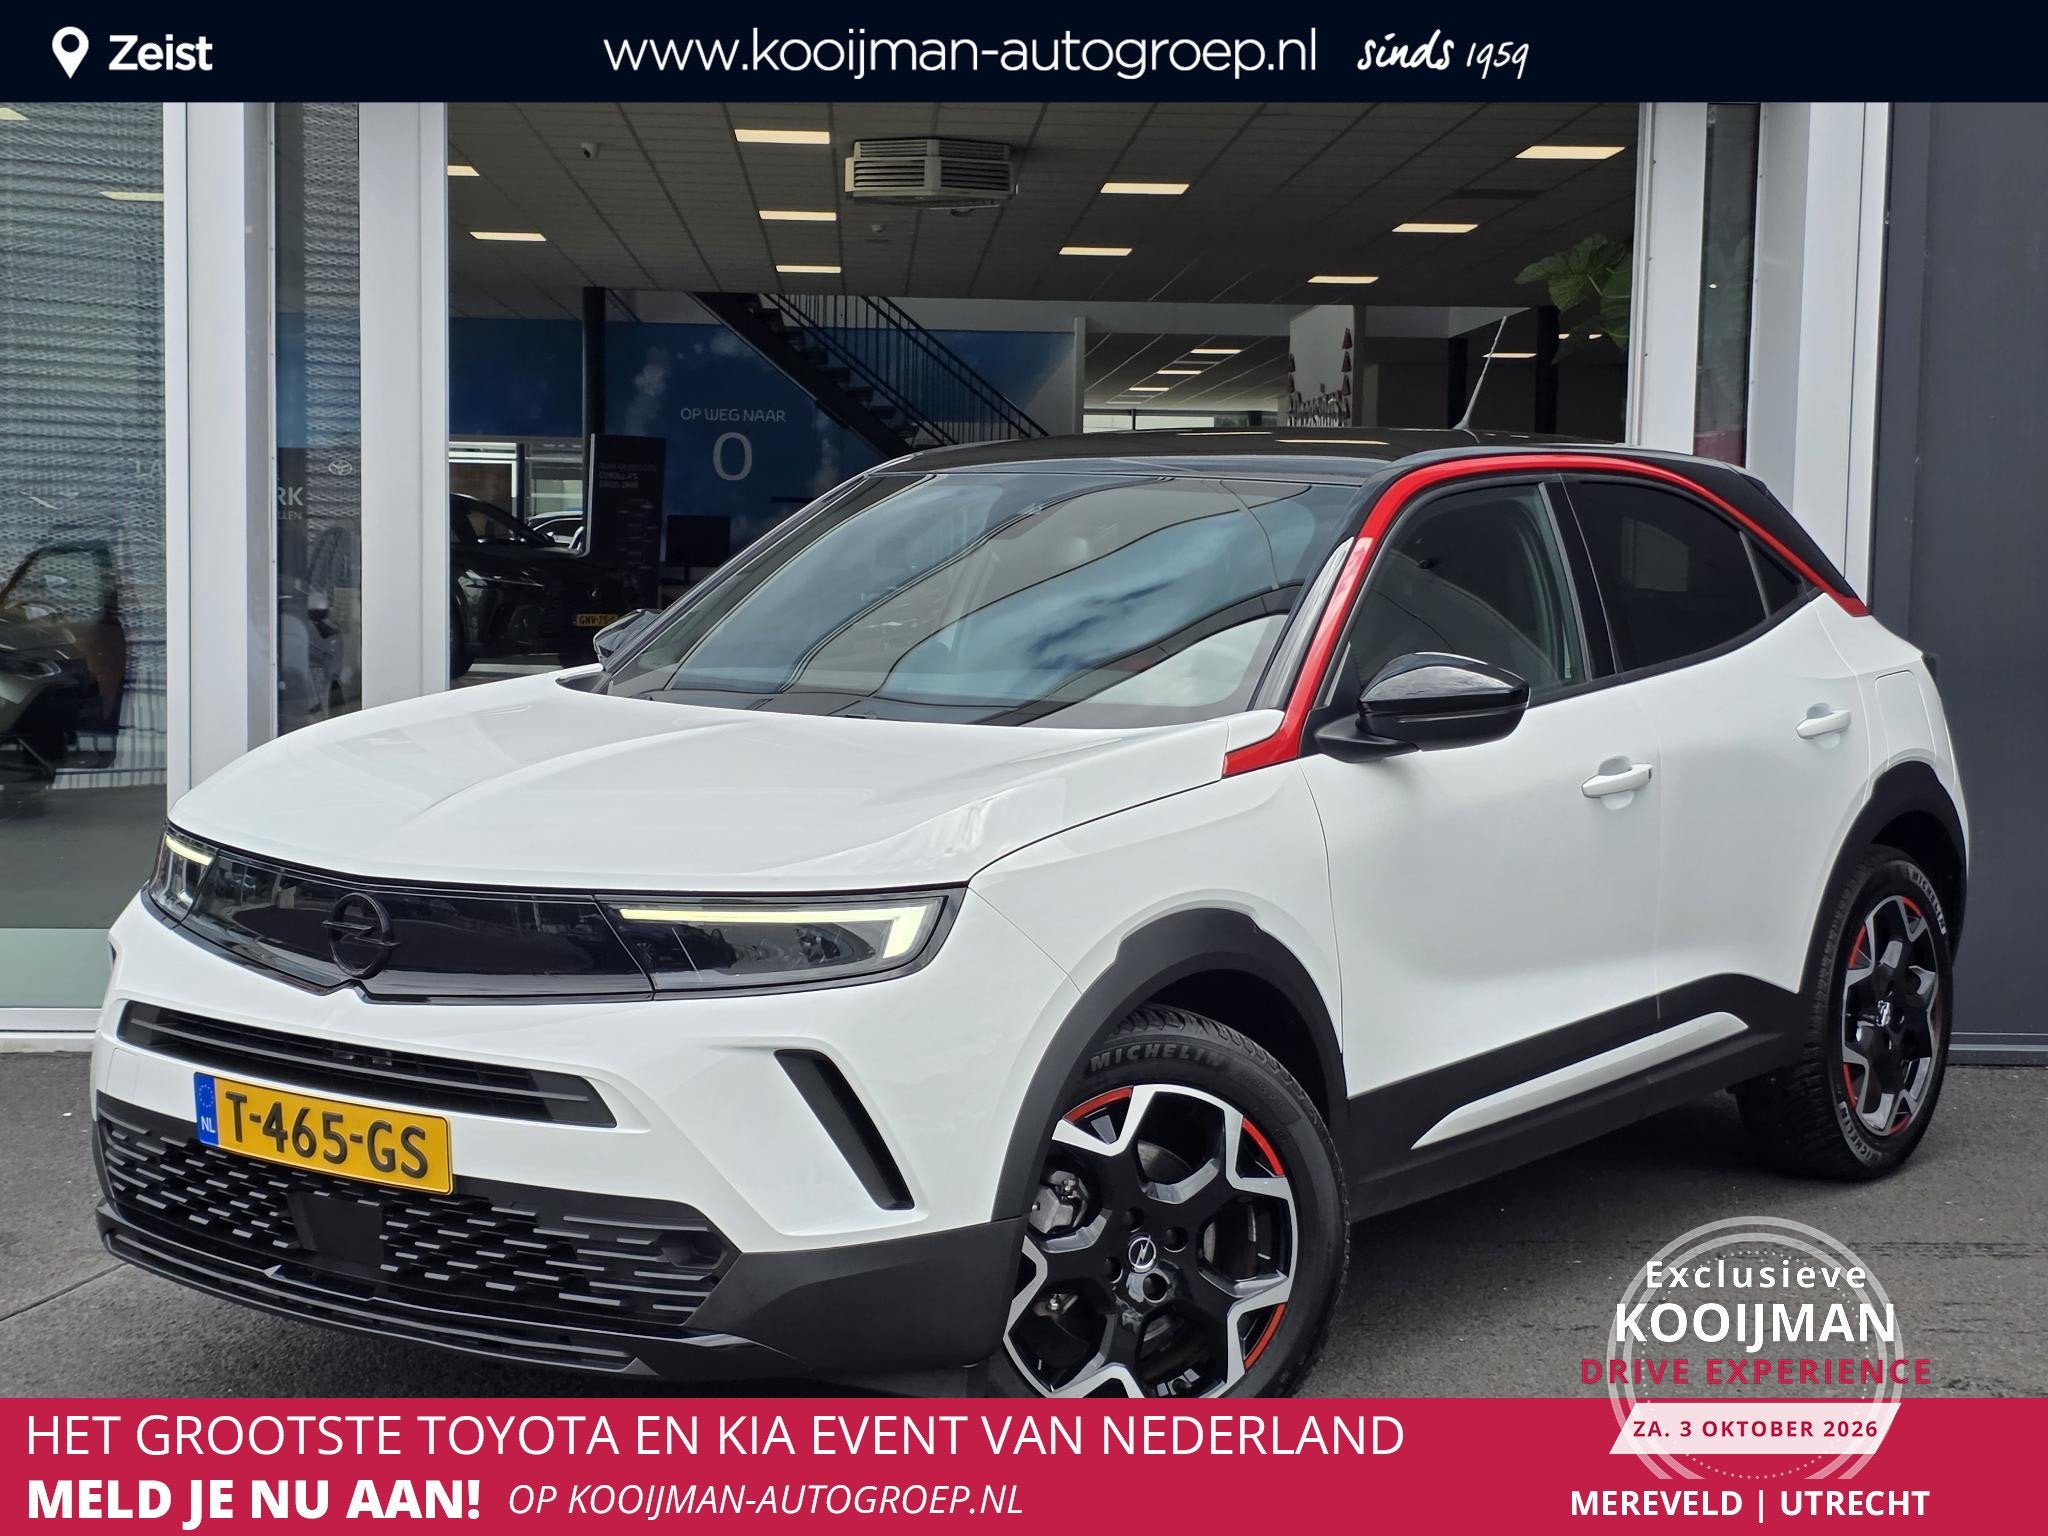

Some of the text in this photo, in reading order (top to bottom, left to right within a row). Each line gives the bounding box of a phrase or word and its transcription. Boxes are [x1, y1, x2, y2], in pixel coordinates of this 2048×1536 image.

[680, 407, 788, 424] OP WEG NAAR
[1089, 1043, 1227, 1074] MICHELIN
[200, 1115, 216, 1134] NL
[225, 1090, 429, 1180] T-465-GS
